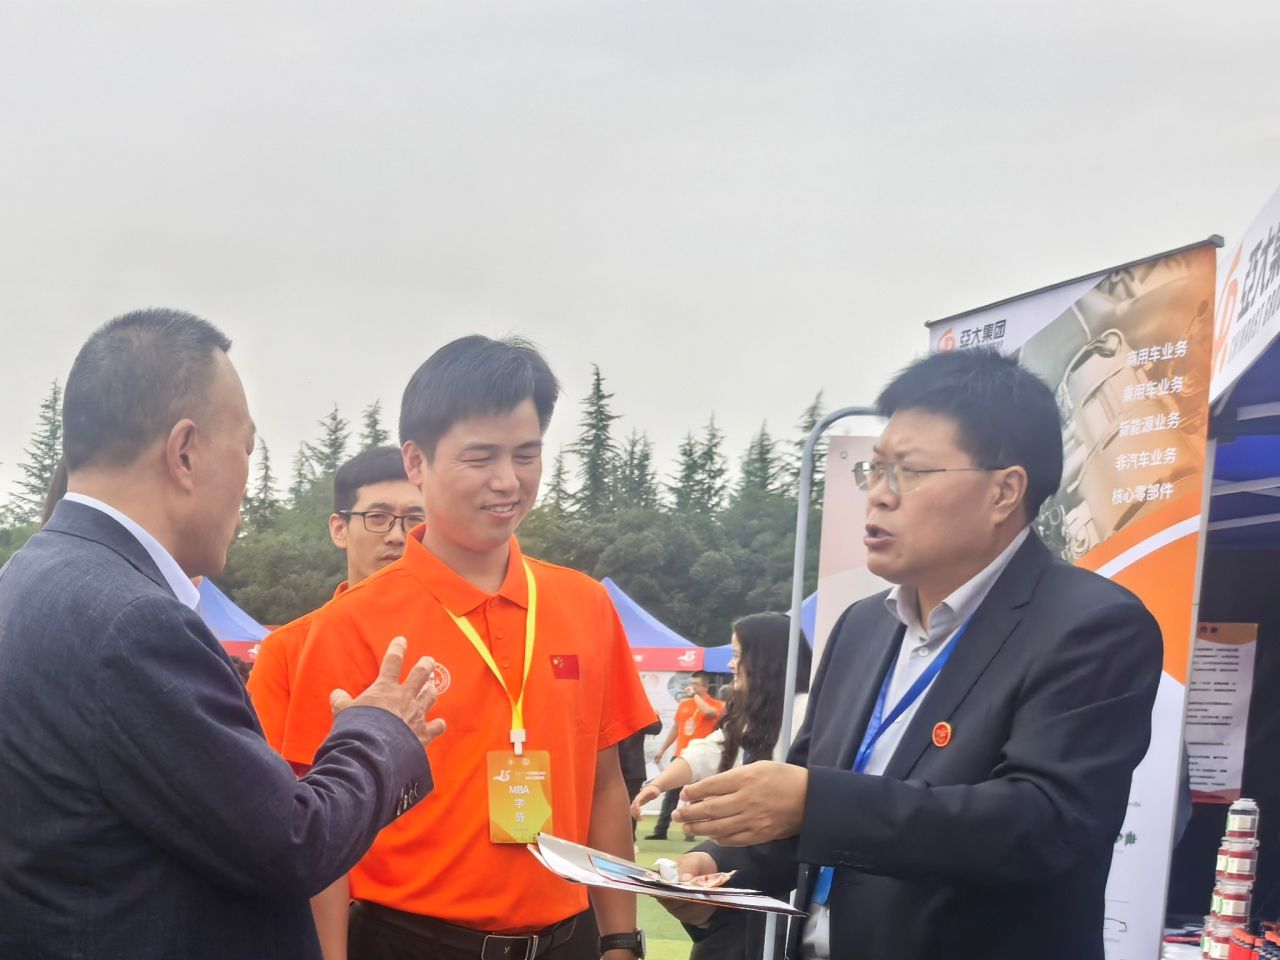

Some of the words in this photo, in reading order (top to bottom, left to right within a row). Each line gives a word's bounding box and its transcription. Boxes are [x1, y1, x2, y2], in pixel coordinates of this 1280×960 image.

[1127, 340, 1188, 367] 商用车业务
[1119, 412, 1181, 437] 新能源业务
[1115, 448, 1177, 471] 非汽车业务
[1111, 482, 1174, 505] 核心零部件
[509, 785, 530, 795] MBA
